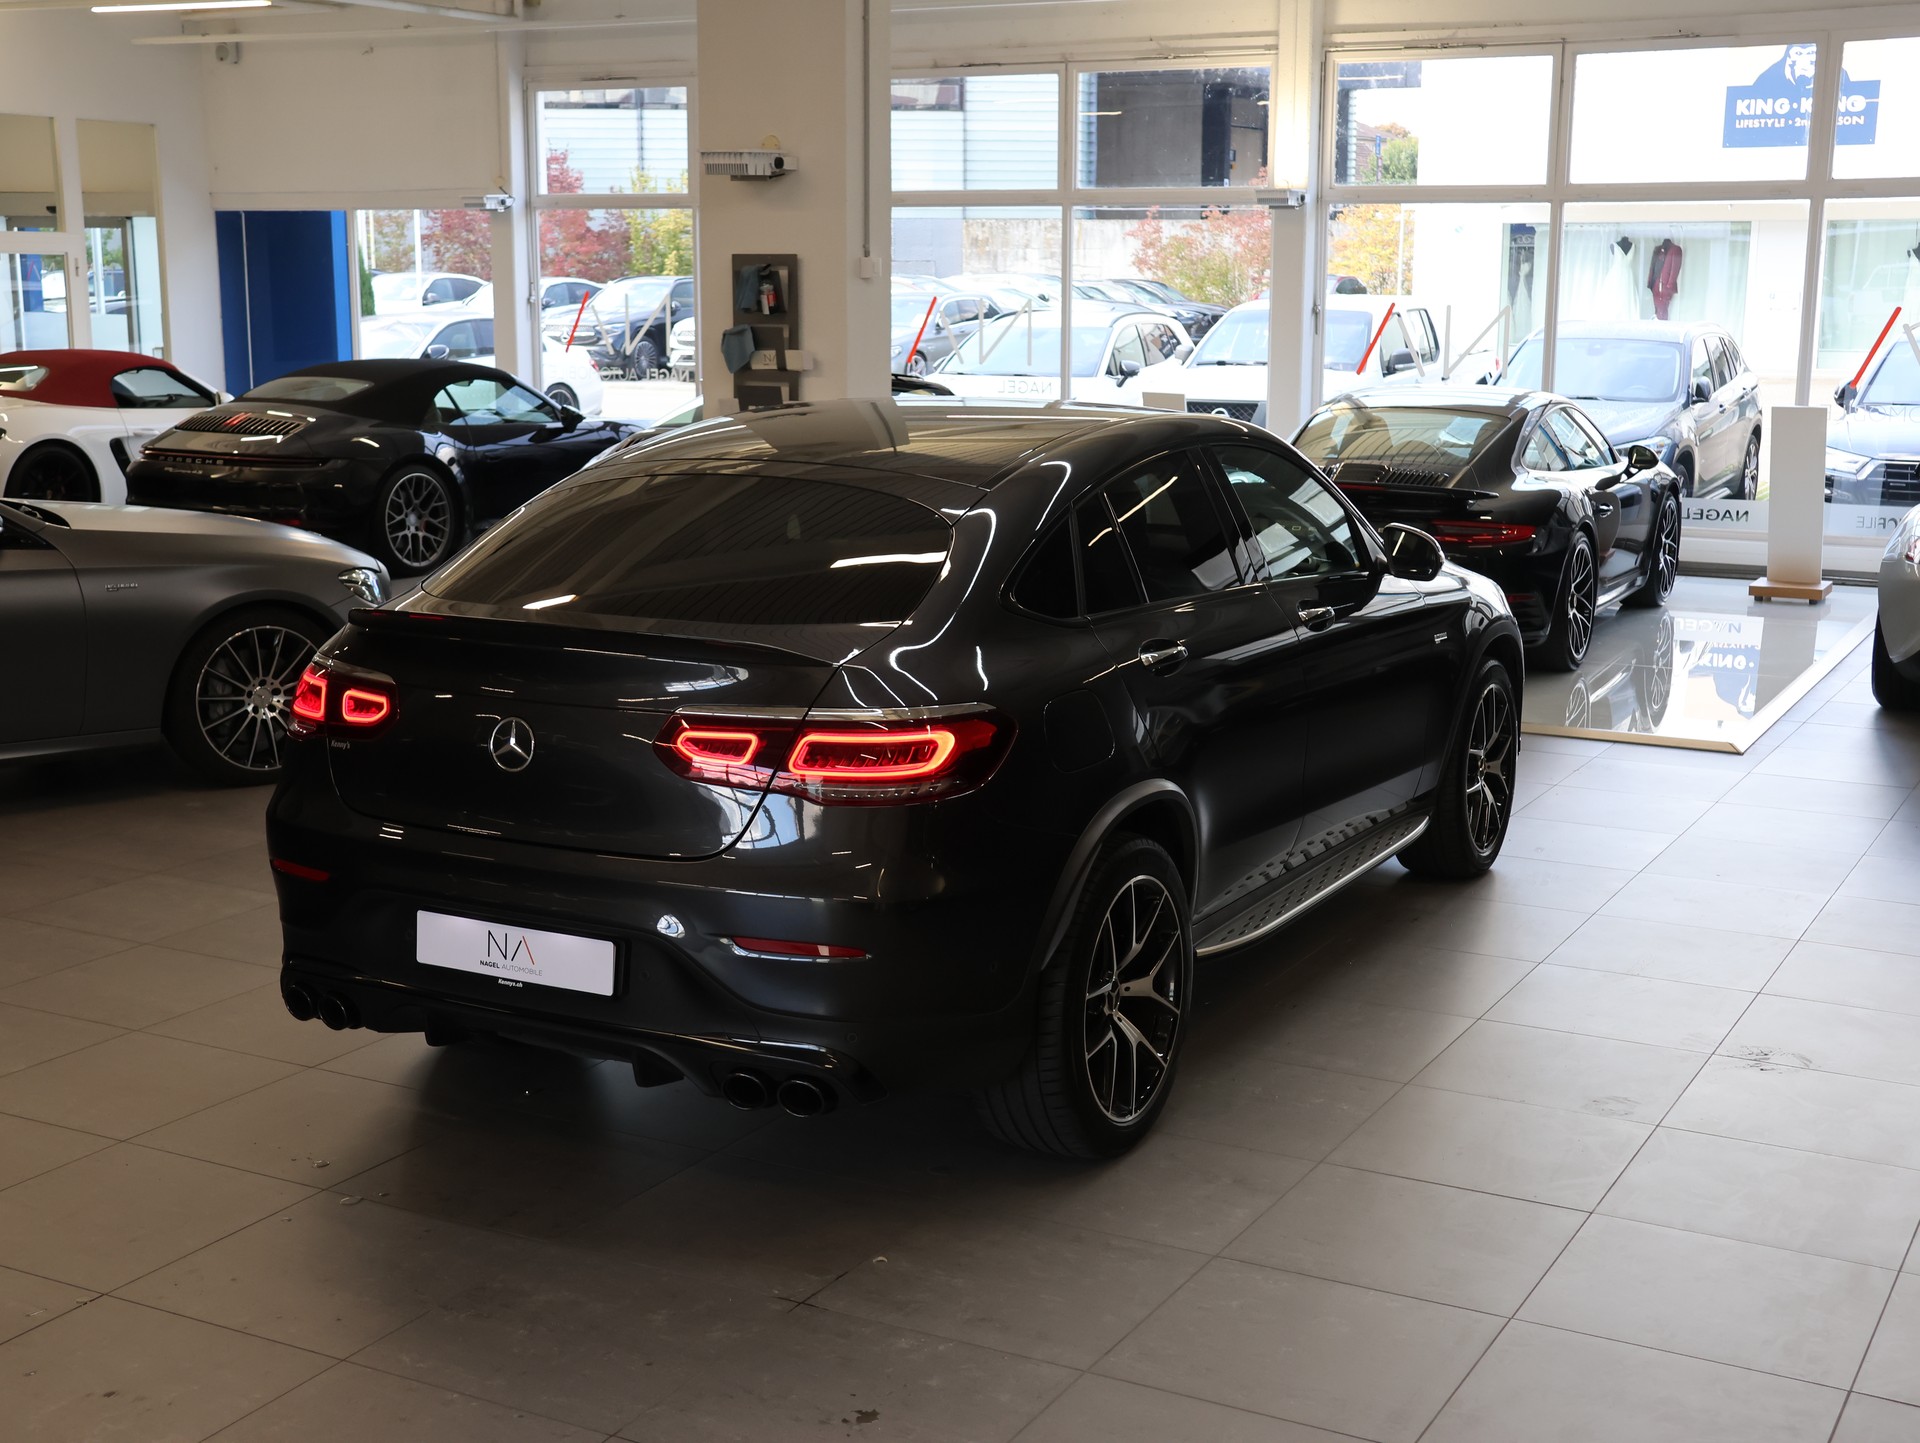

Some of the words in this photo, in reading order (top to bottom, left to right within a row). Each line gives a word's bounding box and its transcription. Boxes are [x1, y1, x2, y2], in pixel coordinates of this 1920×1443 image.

[1801, 95, 1867, 113] KNG
[1736, 118, 1785, 128] LIFESTYLE
[480, 960, 500, 969] NAGEL
[502, 964, 543, 976] AUTOMOBILE
[498, 979, 523, 988] Kennys.ch
